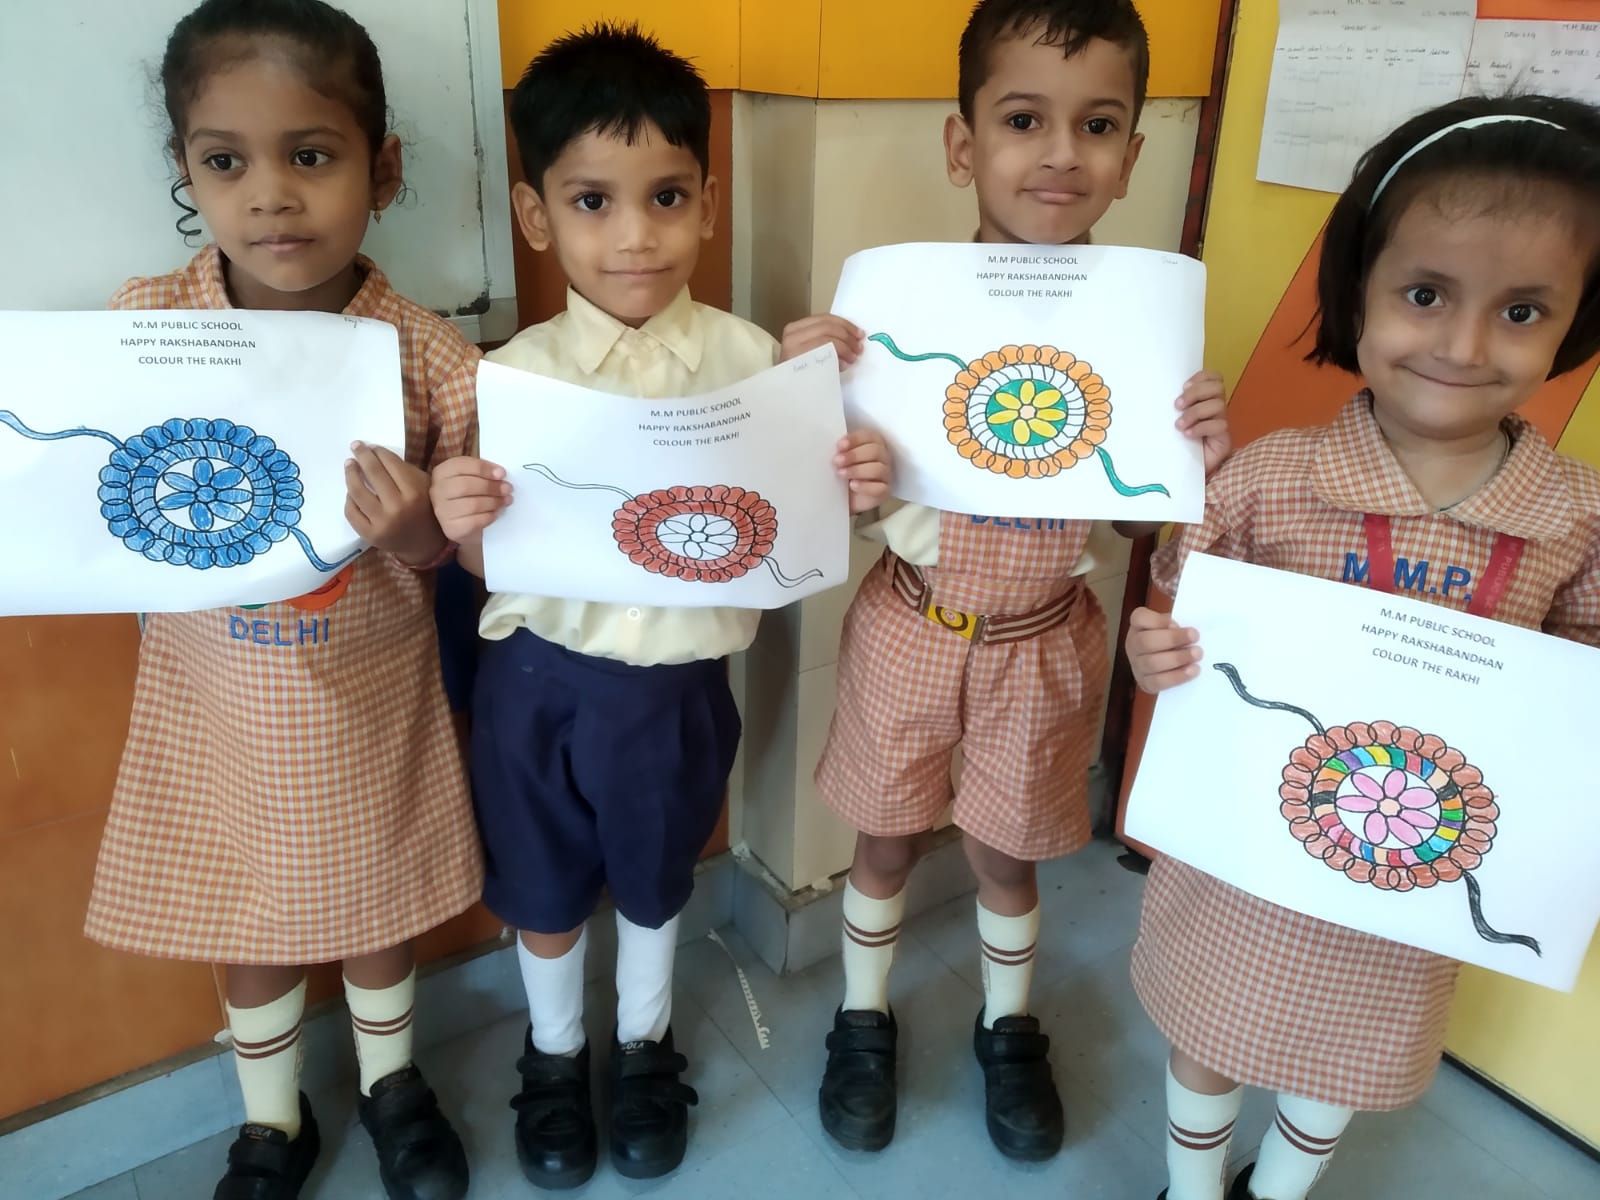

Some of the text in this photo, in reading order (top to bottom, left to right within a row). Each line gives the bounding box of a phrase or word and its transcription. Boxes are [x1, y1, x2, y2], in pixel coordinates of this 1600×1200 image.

[987, 255, 1079, 265] M.M PUBLIC SCHOOL
[976, 272, 1088, 282] HAPPY RAKSHABANDHAN
[988, 288, 1073, 298] COLOUR THE RAKHI
[132, 321, 243, 331] M.M PUBLIC SCHOOL
[120, 338, 256, 349] HAPPY RAKSHABANDHAN
[138, 356, 242, 366] COLOUR THE RAKHI
[676, 406, 709, 417] PUBLIC
[710, 397, 742, 413] SCHOOL
[638, 411, 751, 432] HAPPY RAKSHABANDHAN
[653, 431, 740, 447] COLOUR THE RAKHI
[229, 614, 329, 646] DELHI
[1380, 607, 1496, 648] M.M PUBLIC SCHOOL
[1361, 623, 1504, 671] HAPPY RAKSHABANDHAN
[1372, 647, 1481, 686] COLOUR THE RAKHI
